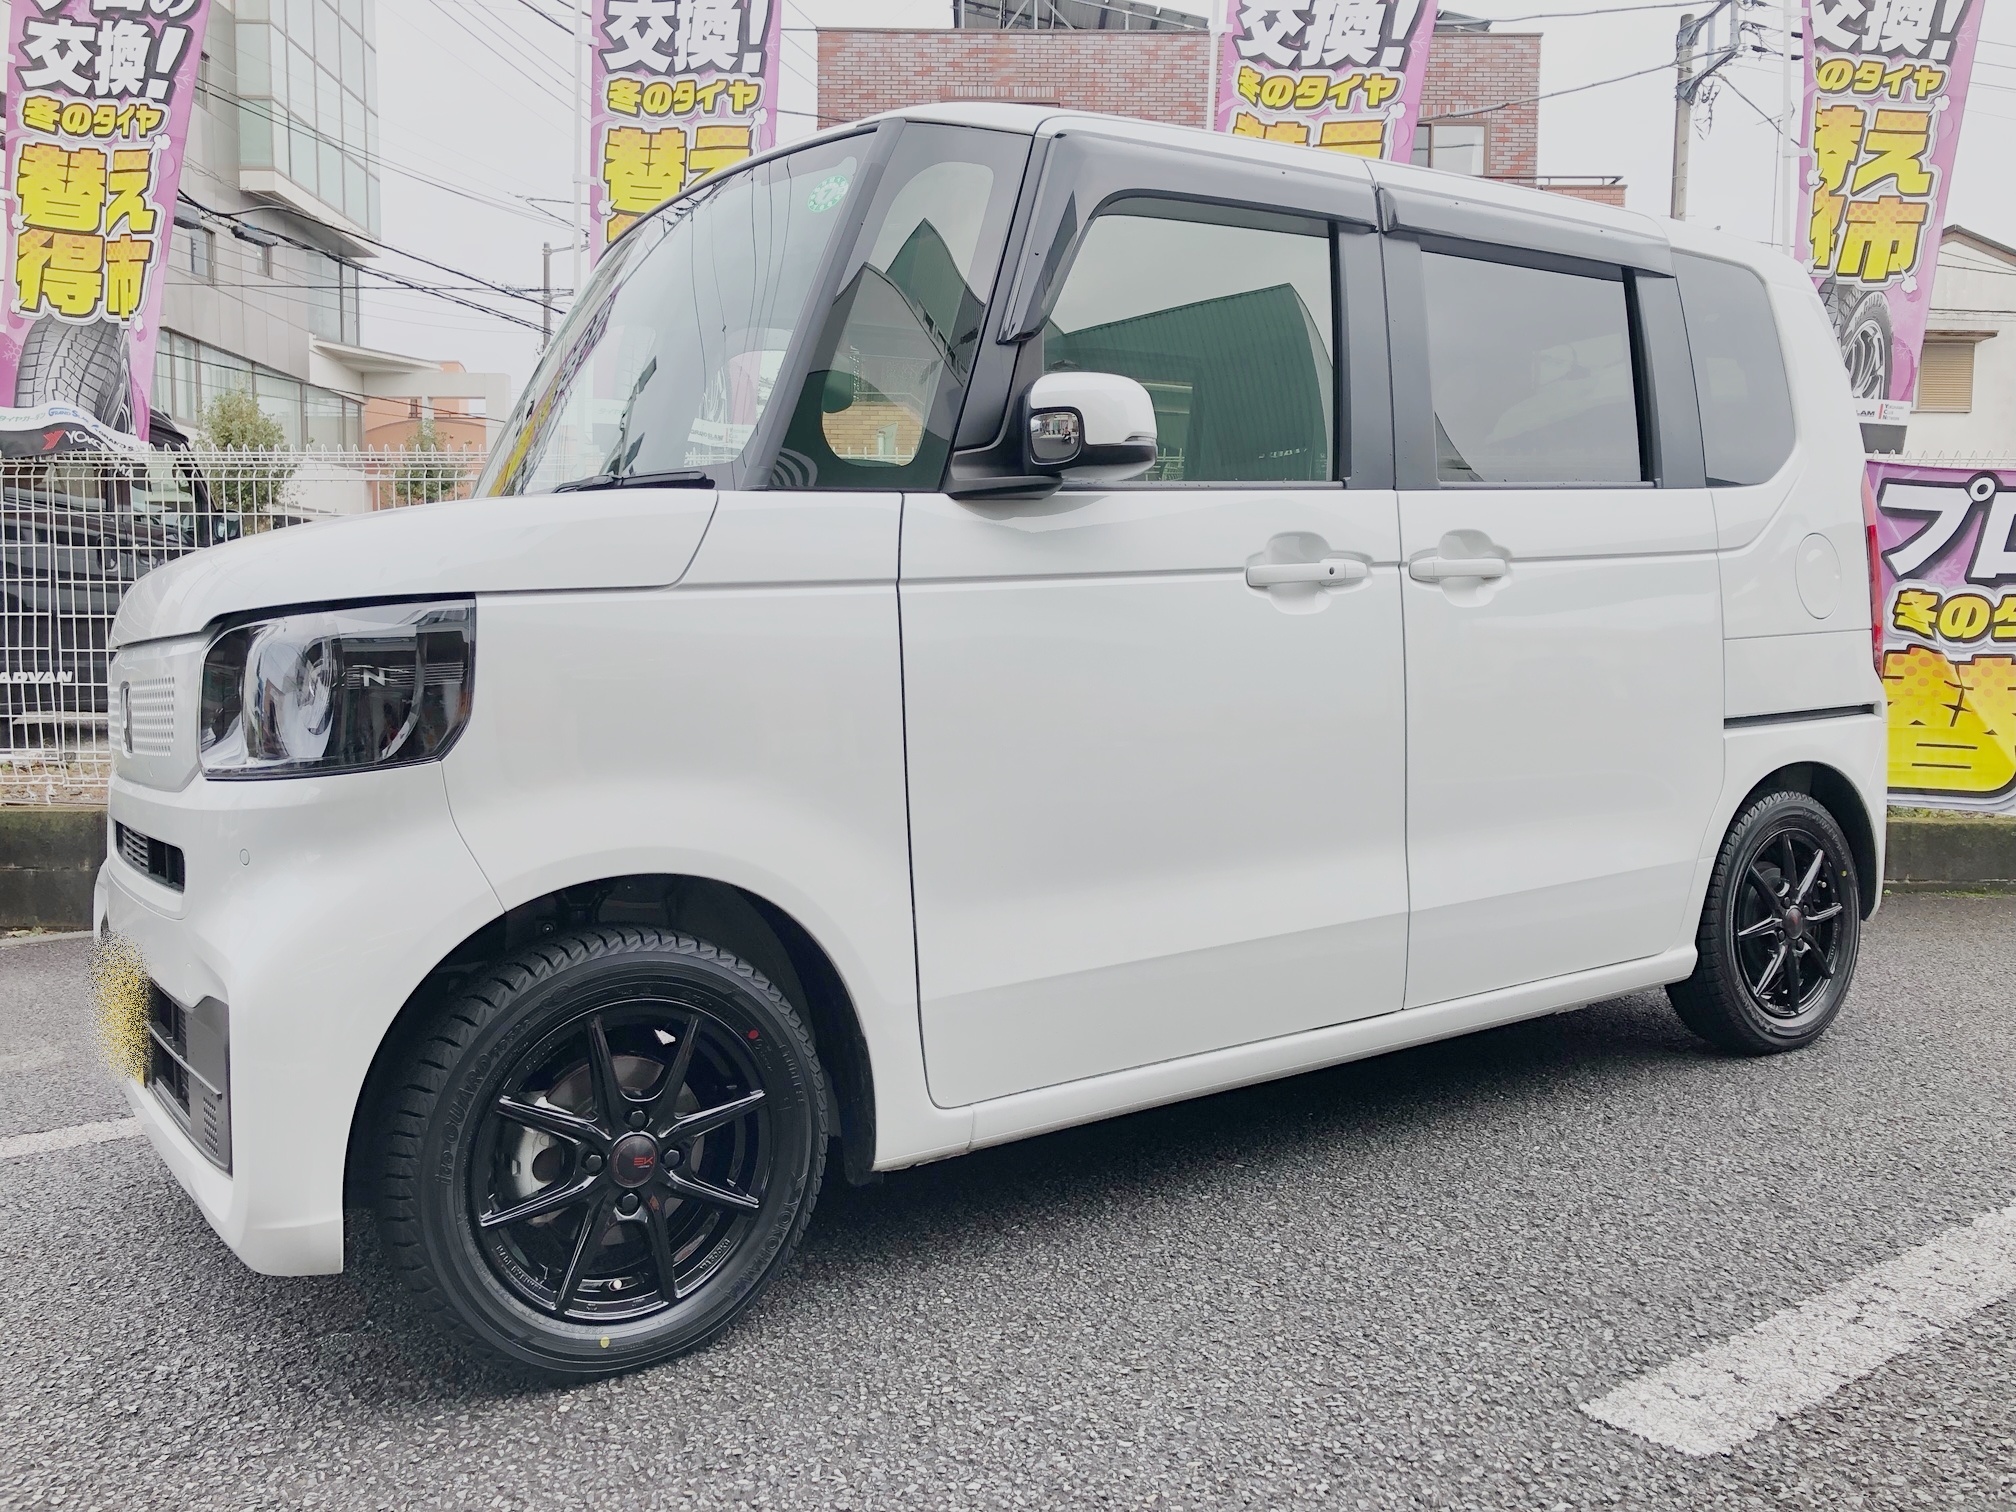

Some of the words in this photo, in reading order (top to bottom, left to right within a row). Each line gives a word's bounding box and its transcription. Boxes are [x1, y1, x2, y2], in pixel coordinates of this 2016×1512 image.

[20, 18, 187, 100] 交換!
[602, 0, 769, 73] 交換!
[607, 78, 760, 117] 冬のタイヤ
[1815, 57, 1946, 99] のタイヤ
[24, 96, 163, 137] 冬のタイヤ
[18, 143, 157, 236] 替え
[15, 229, 150, 321] 得市
[0, 671, 73, 682] ADVAN
[724, 1197, 800, 1300] YOKOHAMA
